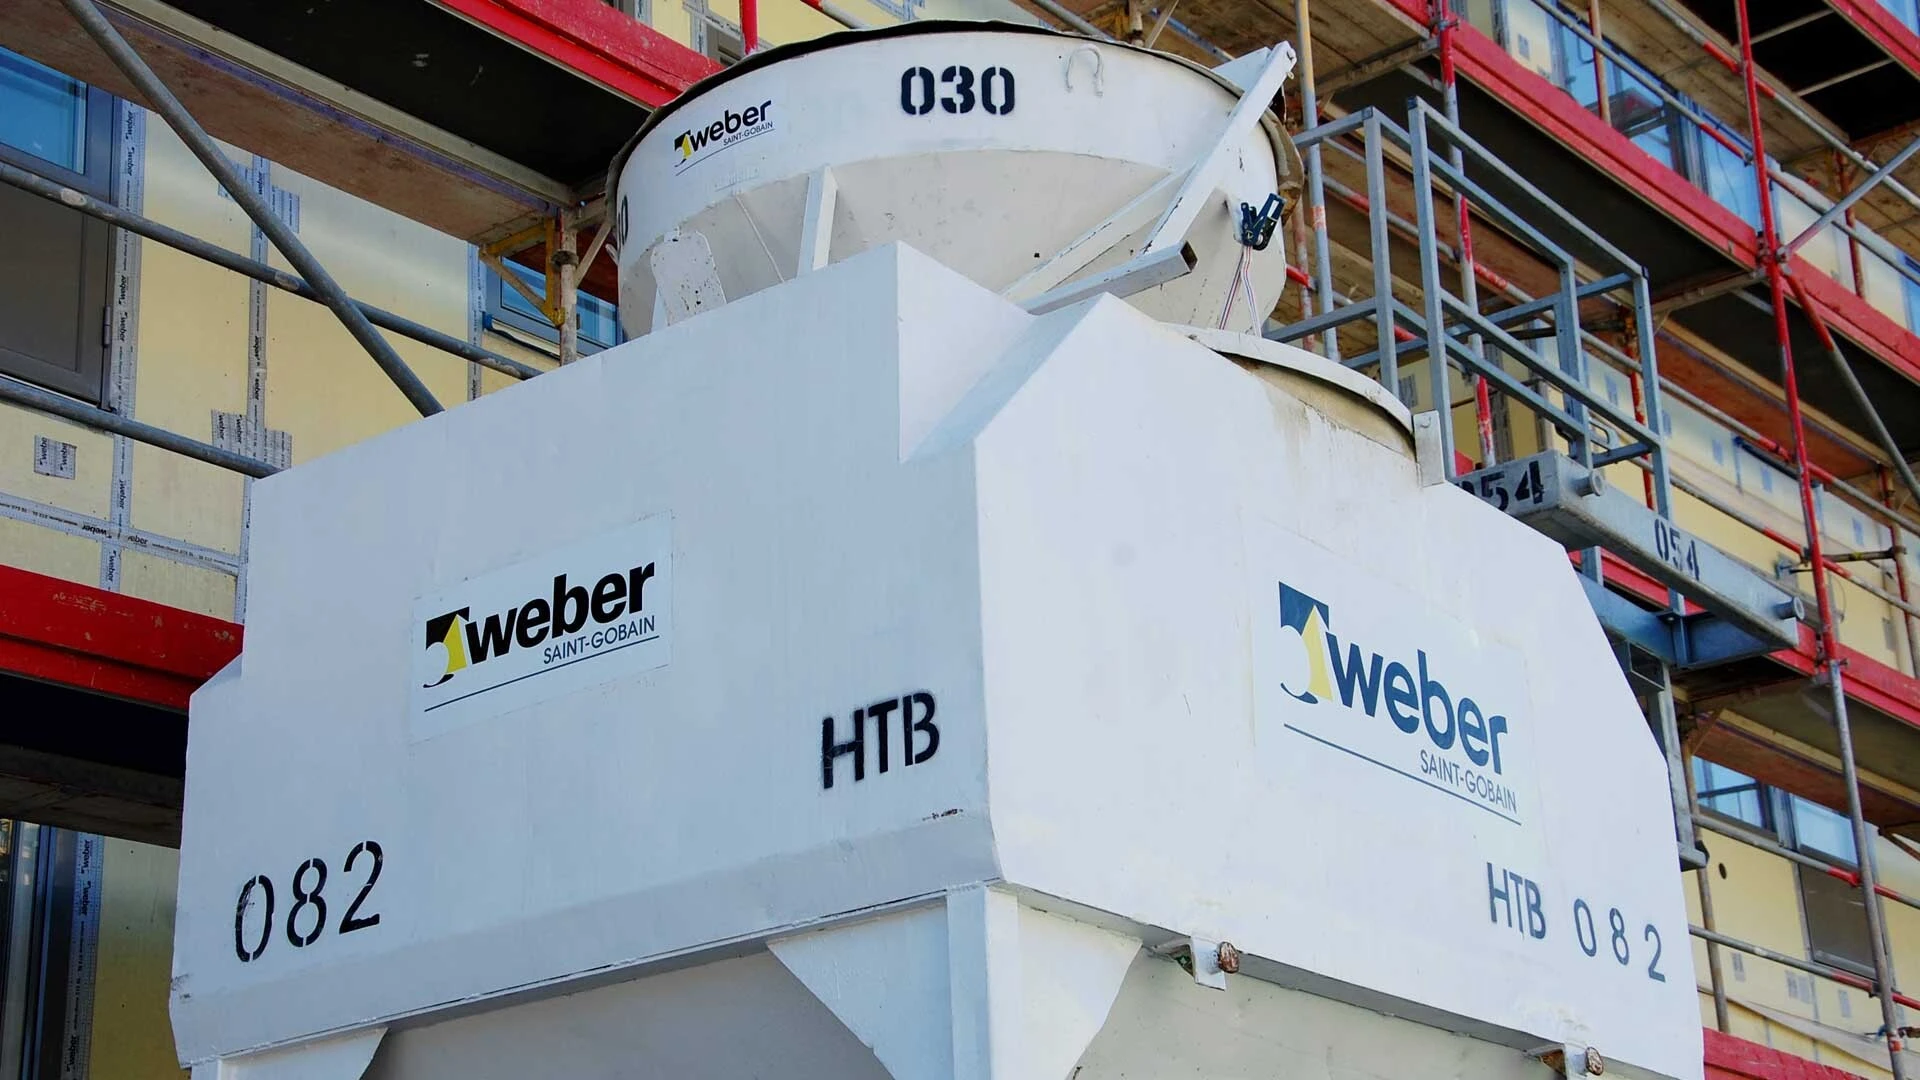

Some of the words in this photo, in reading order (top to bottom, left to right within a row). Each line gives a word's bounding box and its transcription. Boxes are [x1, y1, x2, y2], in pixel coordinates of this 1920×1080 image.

[901, 65, 1015, 115] 030
[125, 110, 135, 136] weber
[690, 100, 772, 152] weber
[723, 121, 774, 146] SAINT-GOBAIN
[127, 153, 136, 176] weber
[118, 274, 128, 301] weber
[119, 315, 128, 342] weber
[119, 482, 127, 509] weber
[82, 525, 107, 537] weber
[1654, 518, 1701, 582] 054
[108, 555, 117, 582] weber
[465, 561, 655, 665] weber
[543, 615, 655, 664] SAINT-GOBAIN
[1325, 648, 1508, 776] weber
[821, 691, 940, 789] HTB
[1420, 749, 1517, 814] SAINT-GOBAIN
[81, 839, 91, 868] weber
[234, 840, 384, 963] 082
[1486, 862, 1546, 940] HTB
